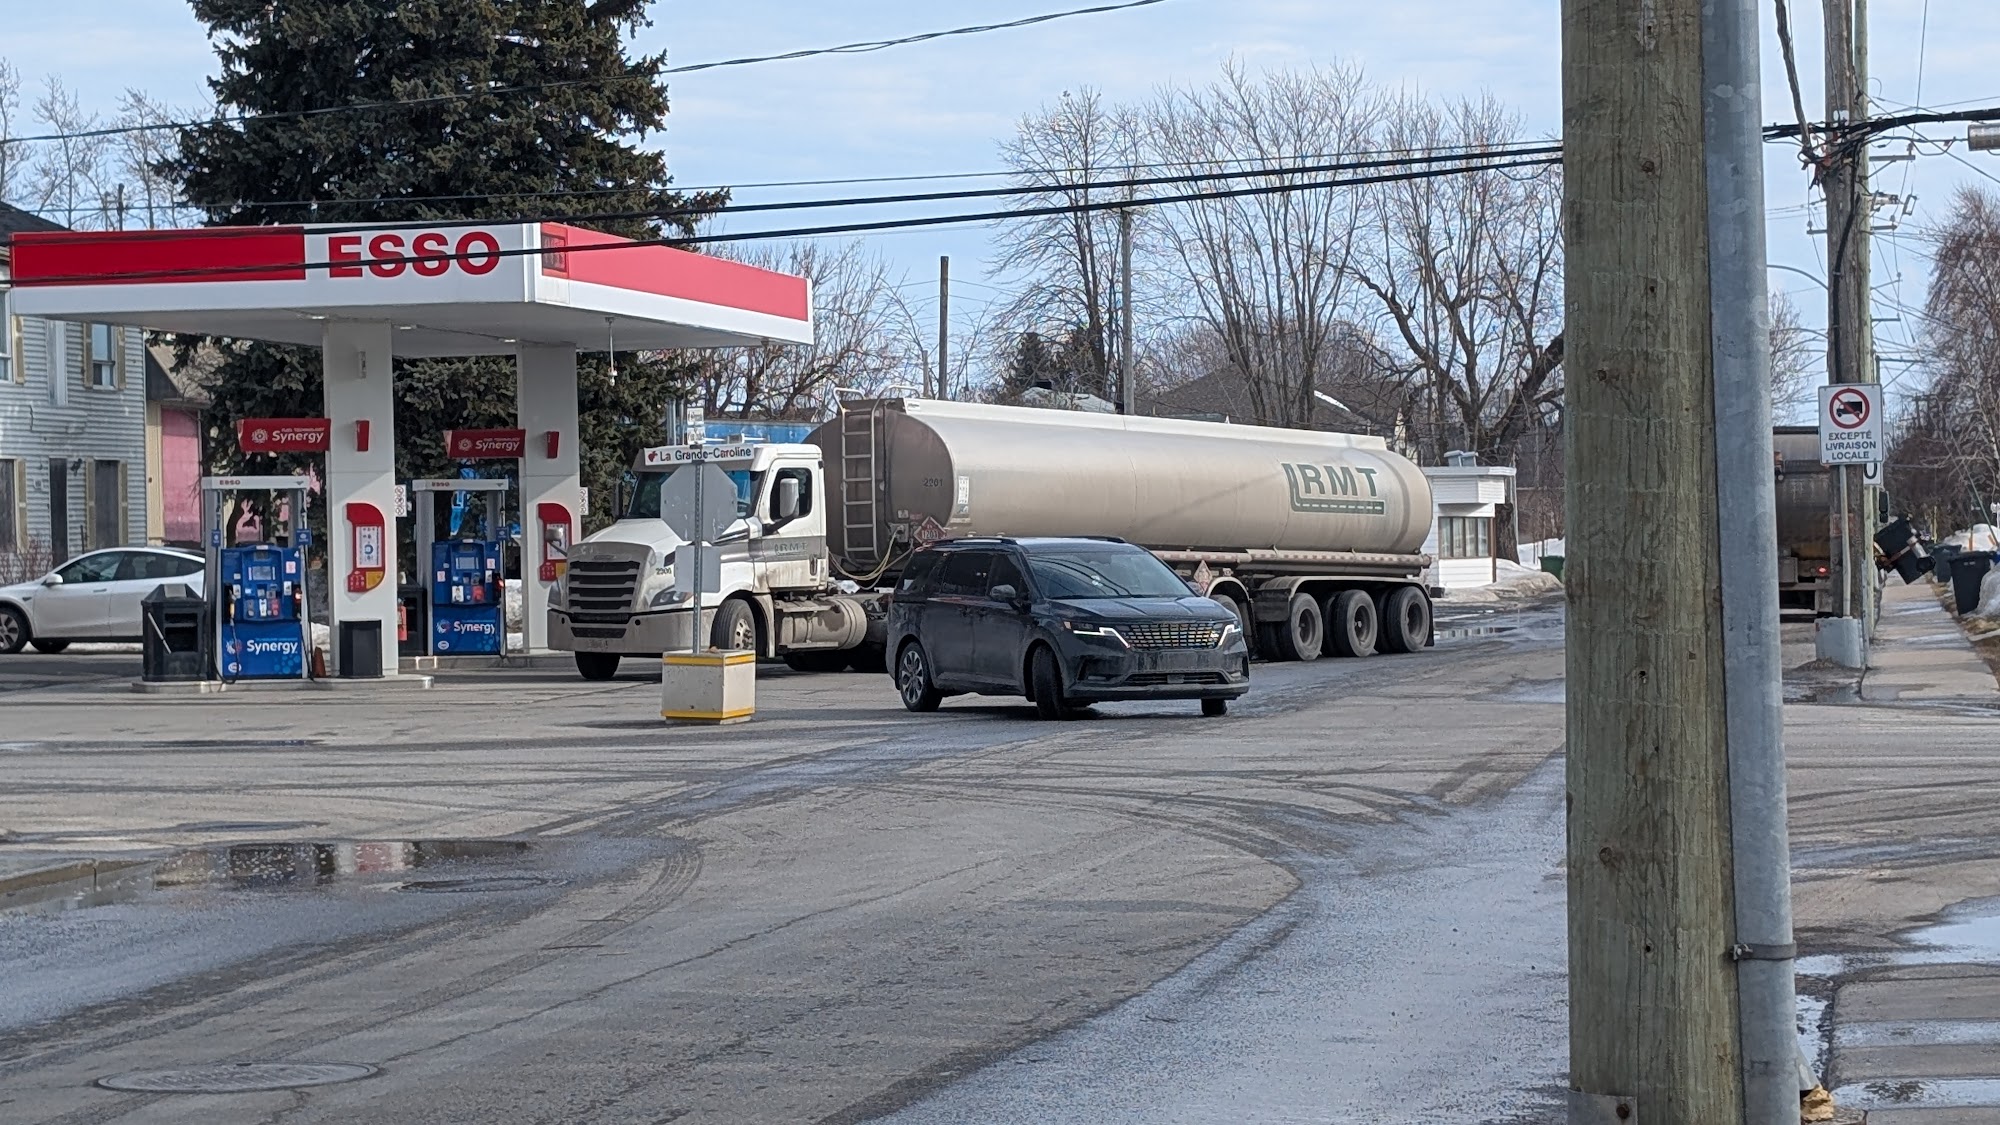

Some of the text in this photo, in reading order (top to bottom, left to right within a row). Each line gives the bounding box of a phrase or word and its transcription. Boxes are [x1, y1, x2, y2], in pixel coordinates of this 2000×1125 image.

[328, 231, 500, 278] ESSO
[271, 430, 324, 444] Synergy
[1828, 430, 1872, 440] EXCEPTÉ
[475, 440, 520, 452] Synergy
[1825, 441, 1876, 450] LIVRAISON
[660, 446, 752, 461] La Grande-Caroline
[1832, 451, 1869, 460] LOCALE
[293, 550, 300, 559] 4
[453, 621, 495, 634] Synergy
[246, 639, 298, 655] Synergy
